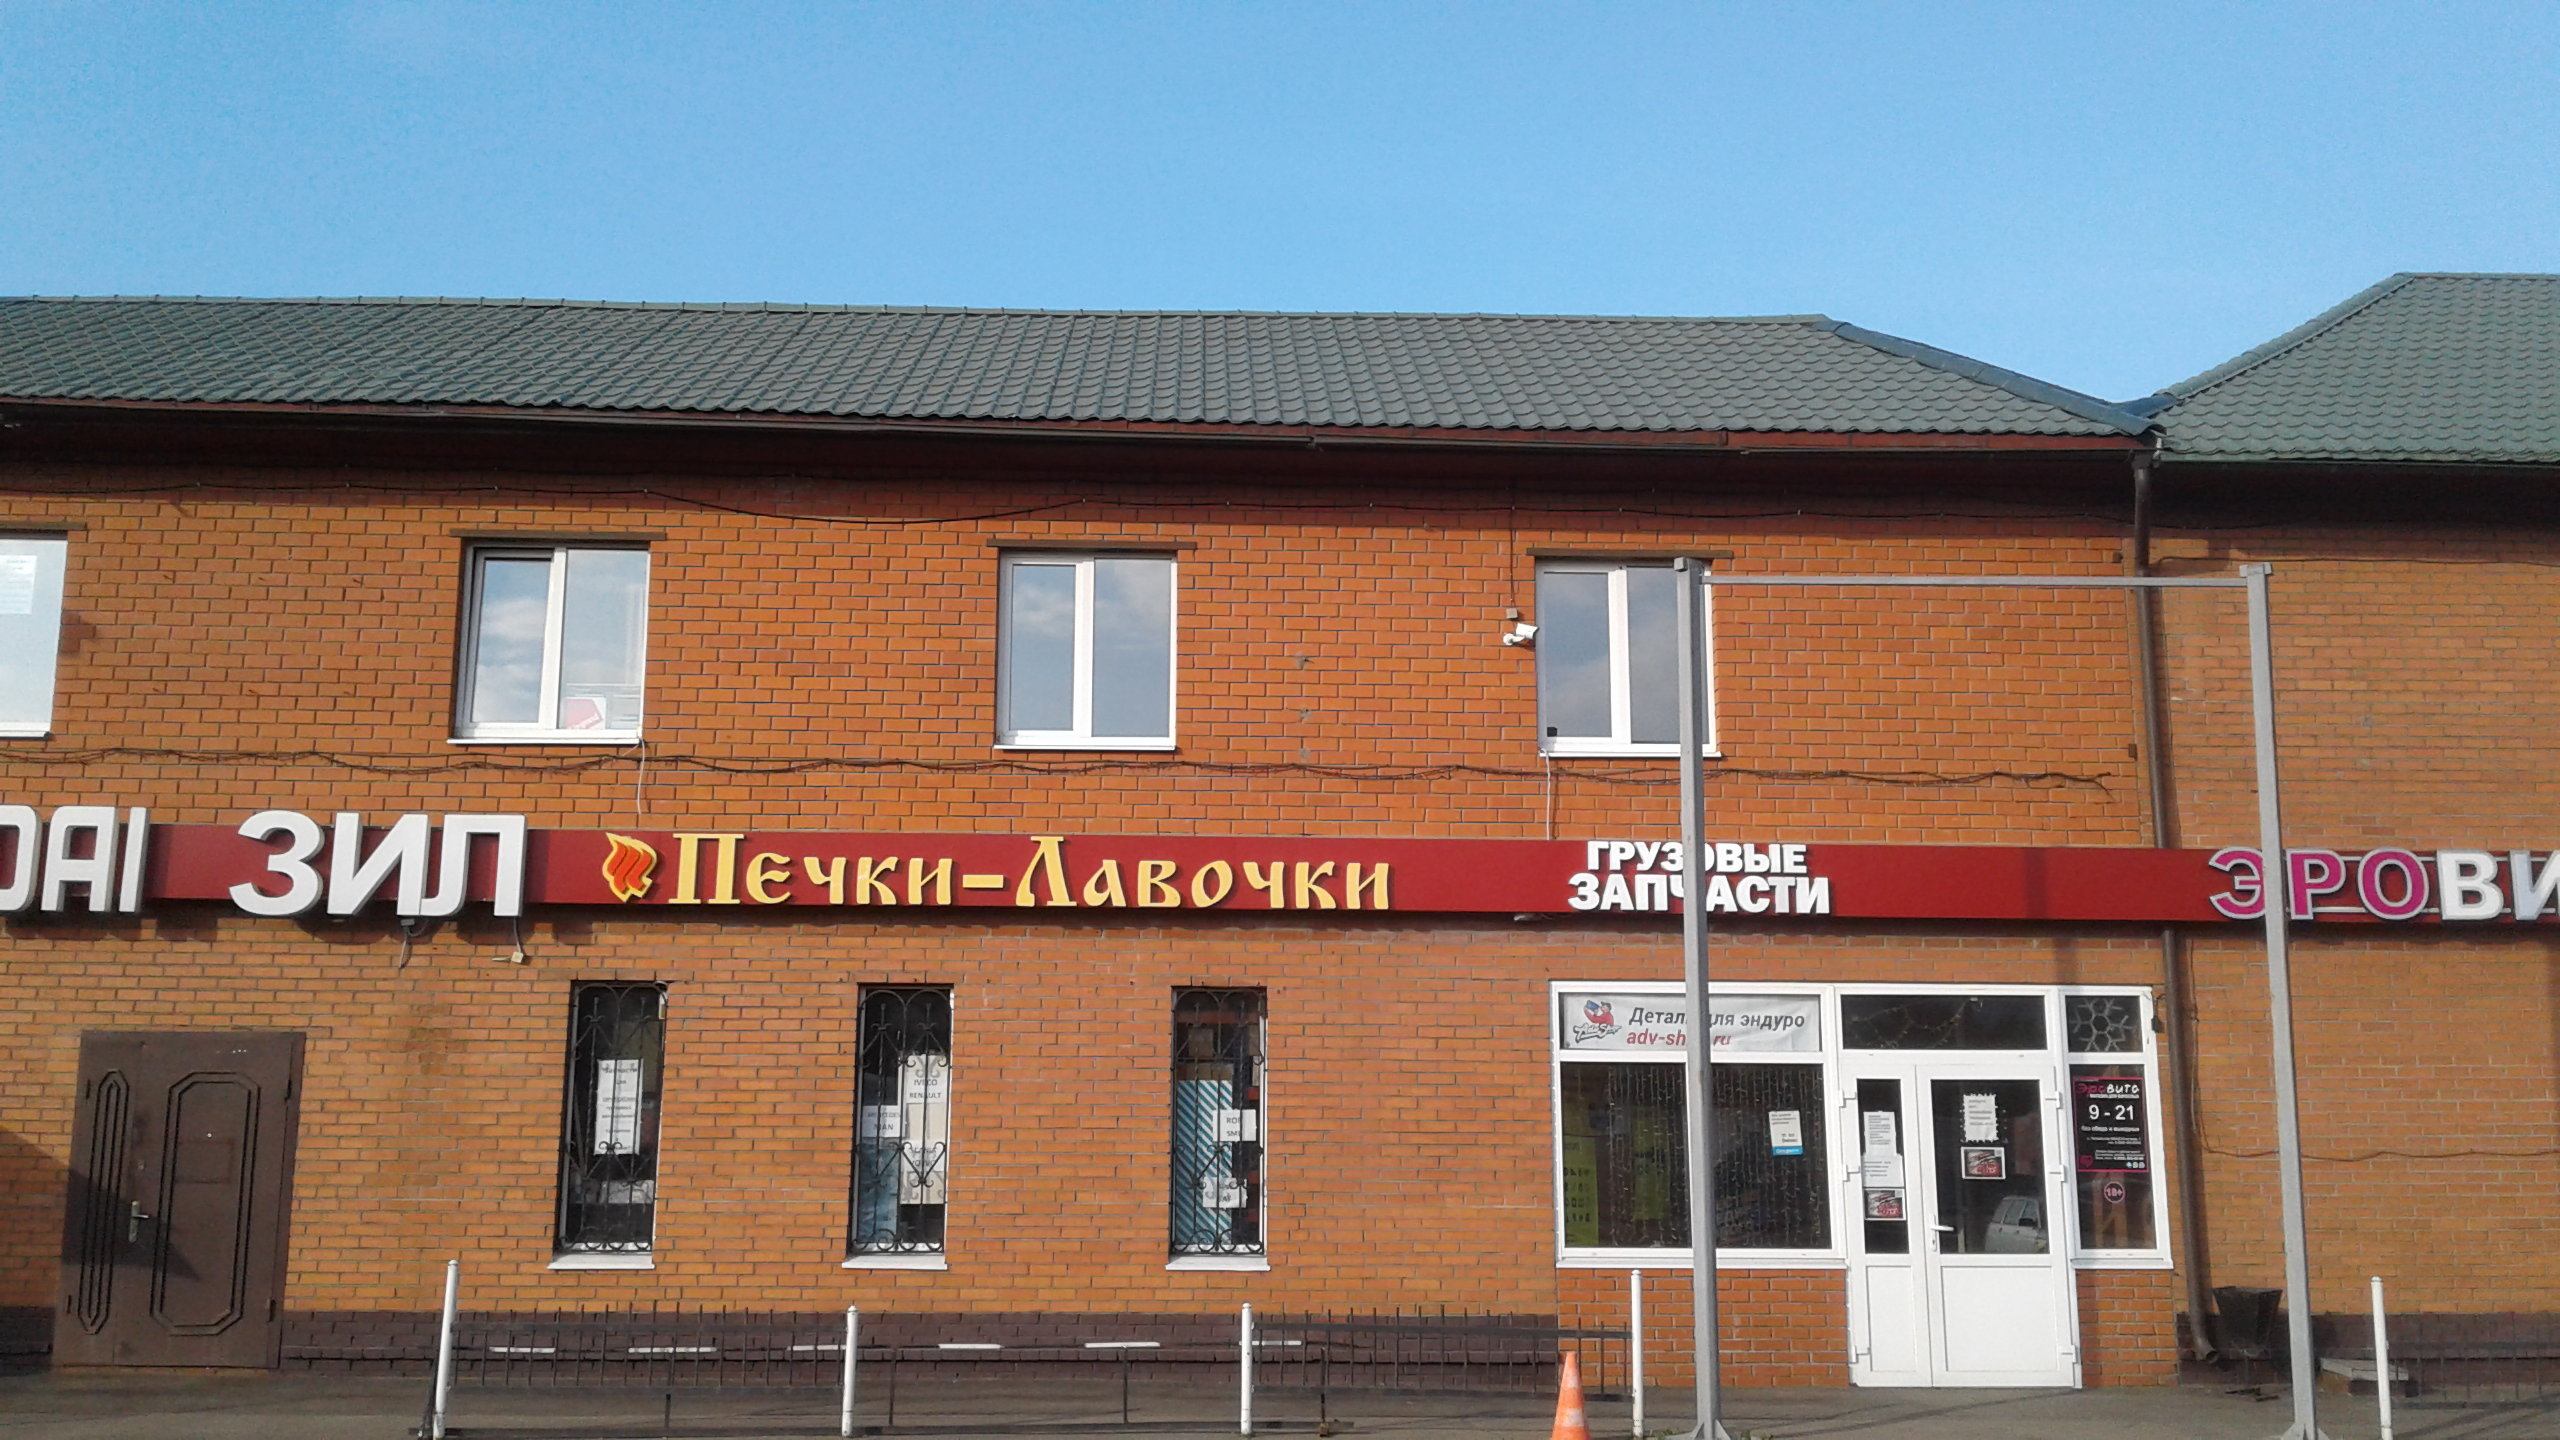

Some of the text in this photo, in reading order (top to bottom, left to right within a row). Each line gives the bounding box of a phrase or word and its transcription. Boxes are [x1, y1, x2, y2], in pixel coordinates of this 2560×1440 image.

[229, 809, 527, 917] ЗИЛ
[1587, 840, 1808, 874] ГРУЗВЫЕ
[1628, 1006, 1688, 1026] Детал
[1740, 1013, 1805, 1031] эндуро
[1626, 1028, 1732, 1046] adv-shru
[2088, 1104, 2100, 1120] 9
[2115, 1104, 2134, 1121] 21
